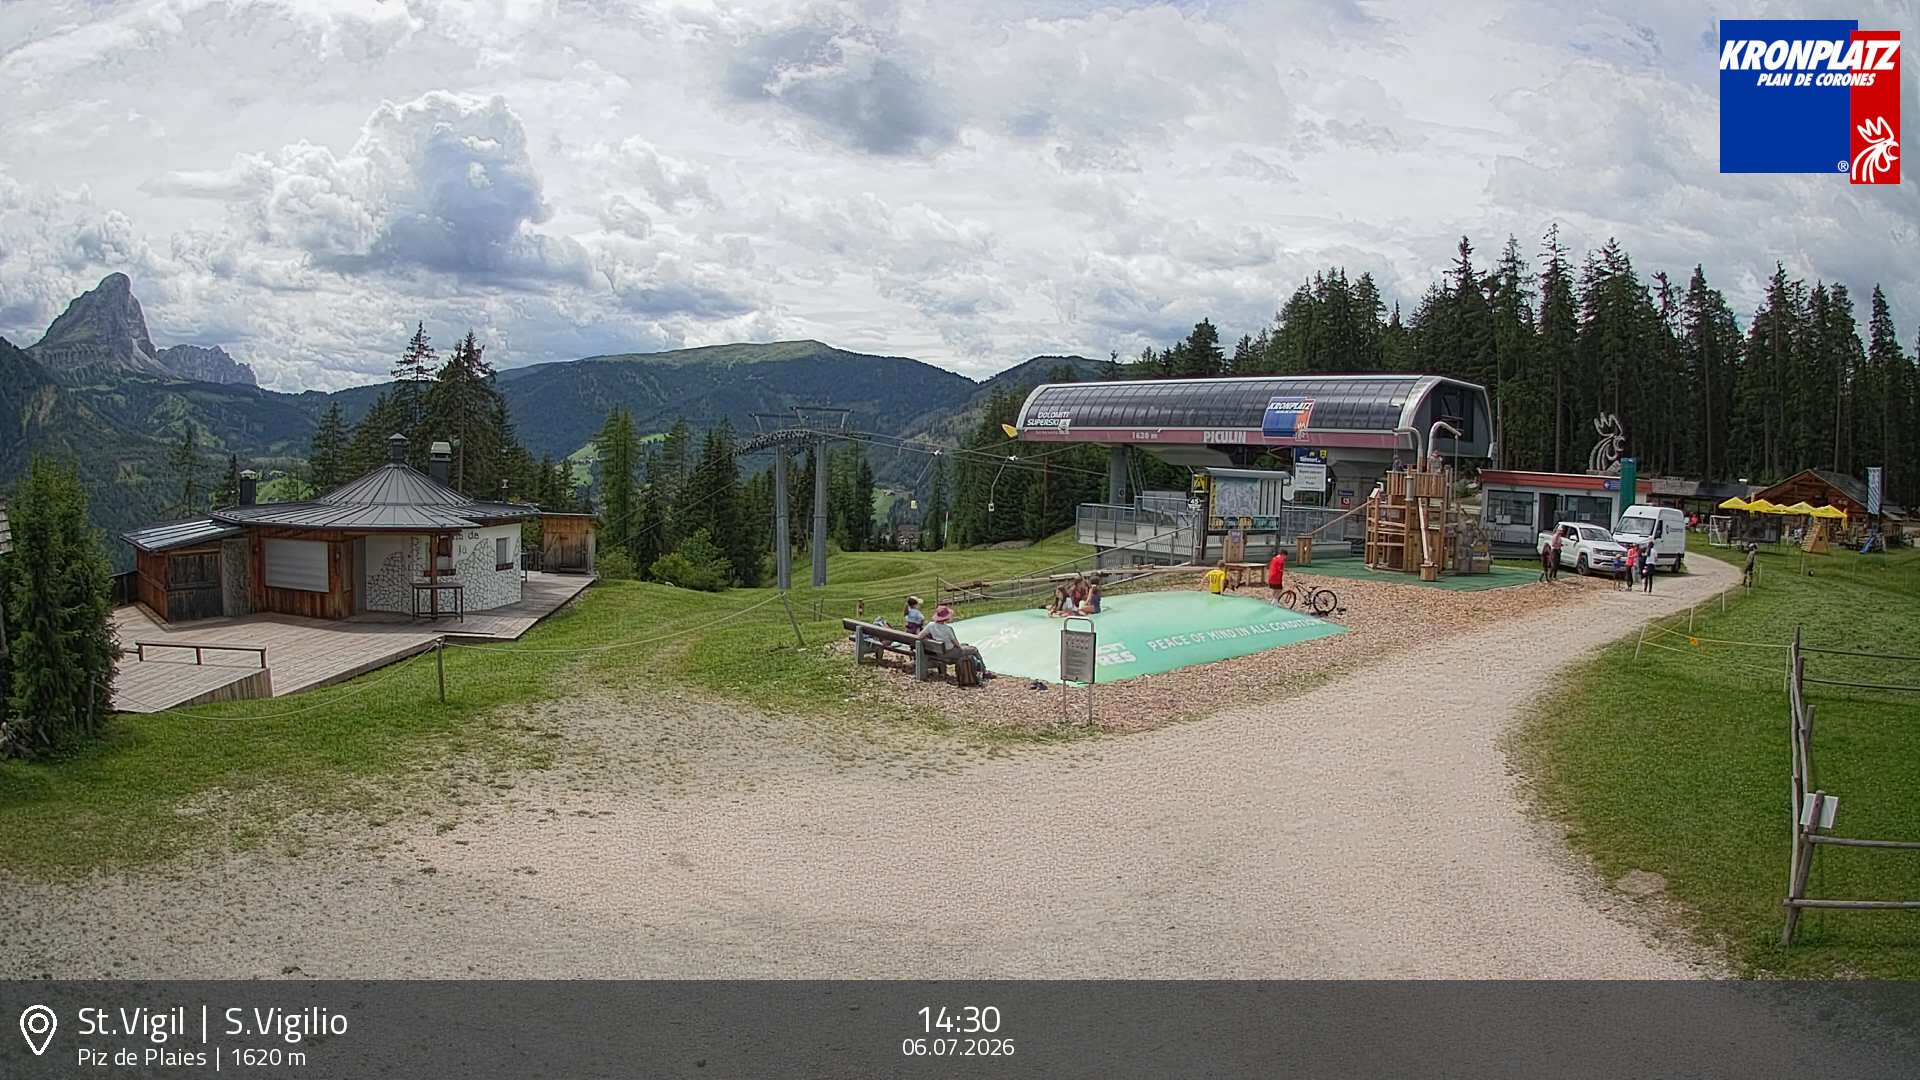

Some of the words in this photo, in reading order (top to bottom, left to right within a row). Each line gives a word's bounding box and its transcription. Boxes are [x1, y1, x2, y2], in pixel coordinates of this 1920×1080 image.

[1203, 431, 1247, 443] PICULIN
[1147, 635, 1191, 652] PEACE
[1191, 632, 1207, 643] OF
[1208, 628, 1237, 641] MIND
[1236, 626, 1250, 637] IN
[1250, 623, 1270, 635] ALL
